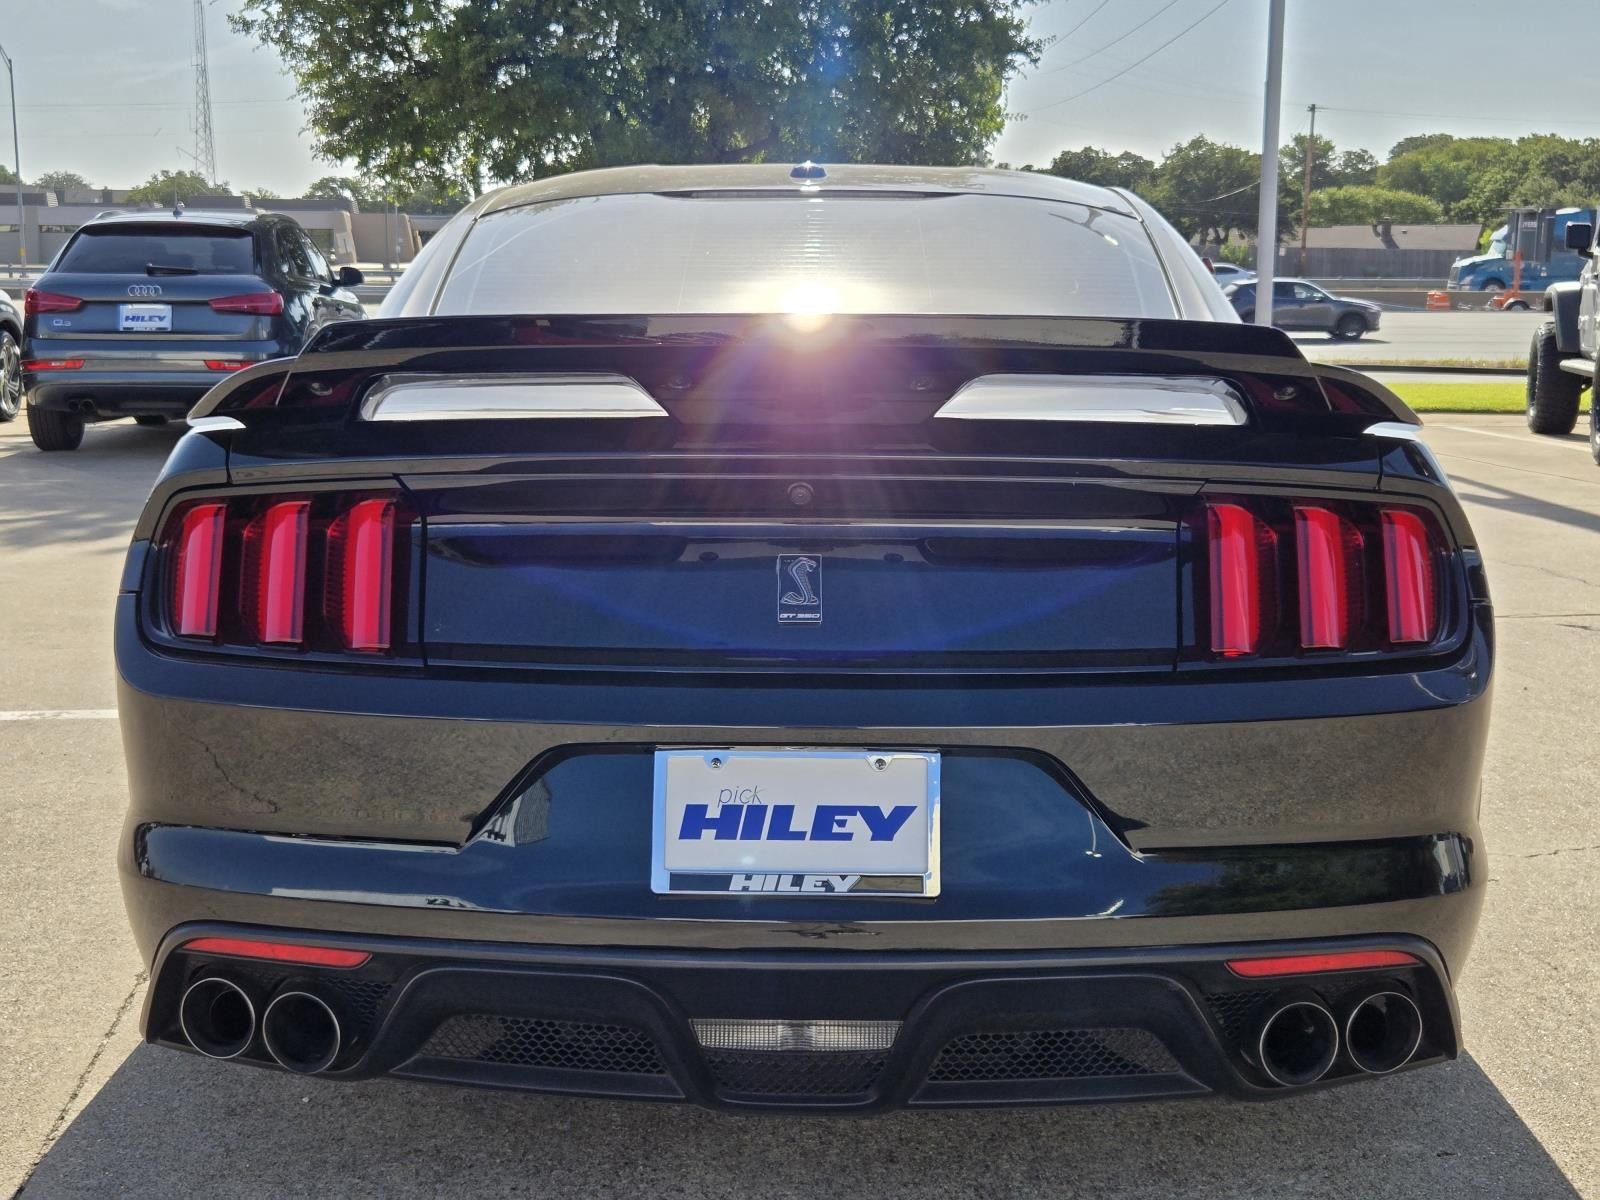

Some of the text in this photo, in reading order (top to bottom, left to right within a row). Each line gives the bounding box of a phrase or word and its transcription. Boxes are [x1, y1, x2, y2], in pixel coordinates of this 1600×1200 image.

[718, 785, 762, 807] pick
[678, 804, 917, 841] HILEY
[730, 873, 861, 892] HILEY
